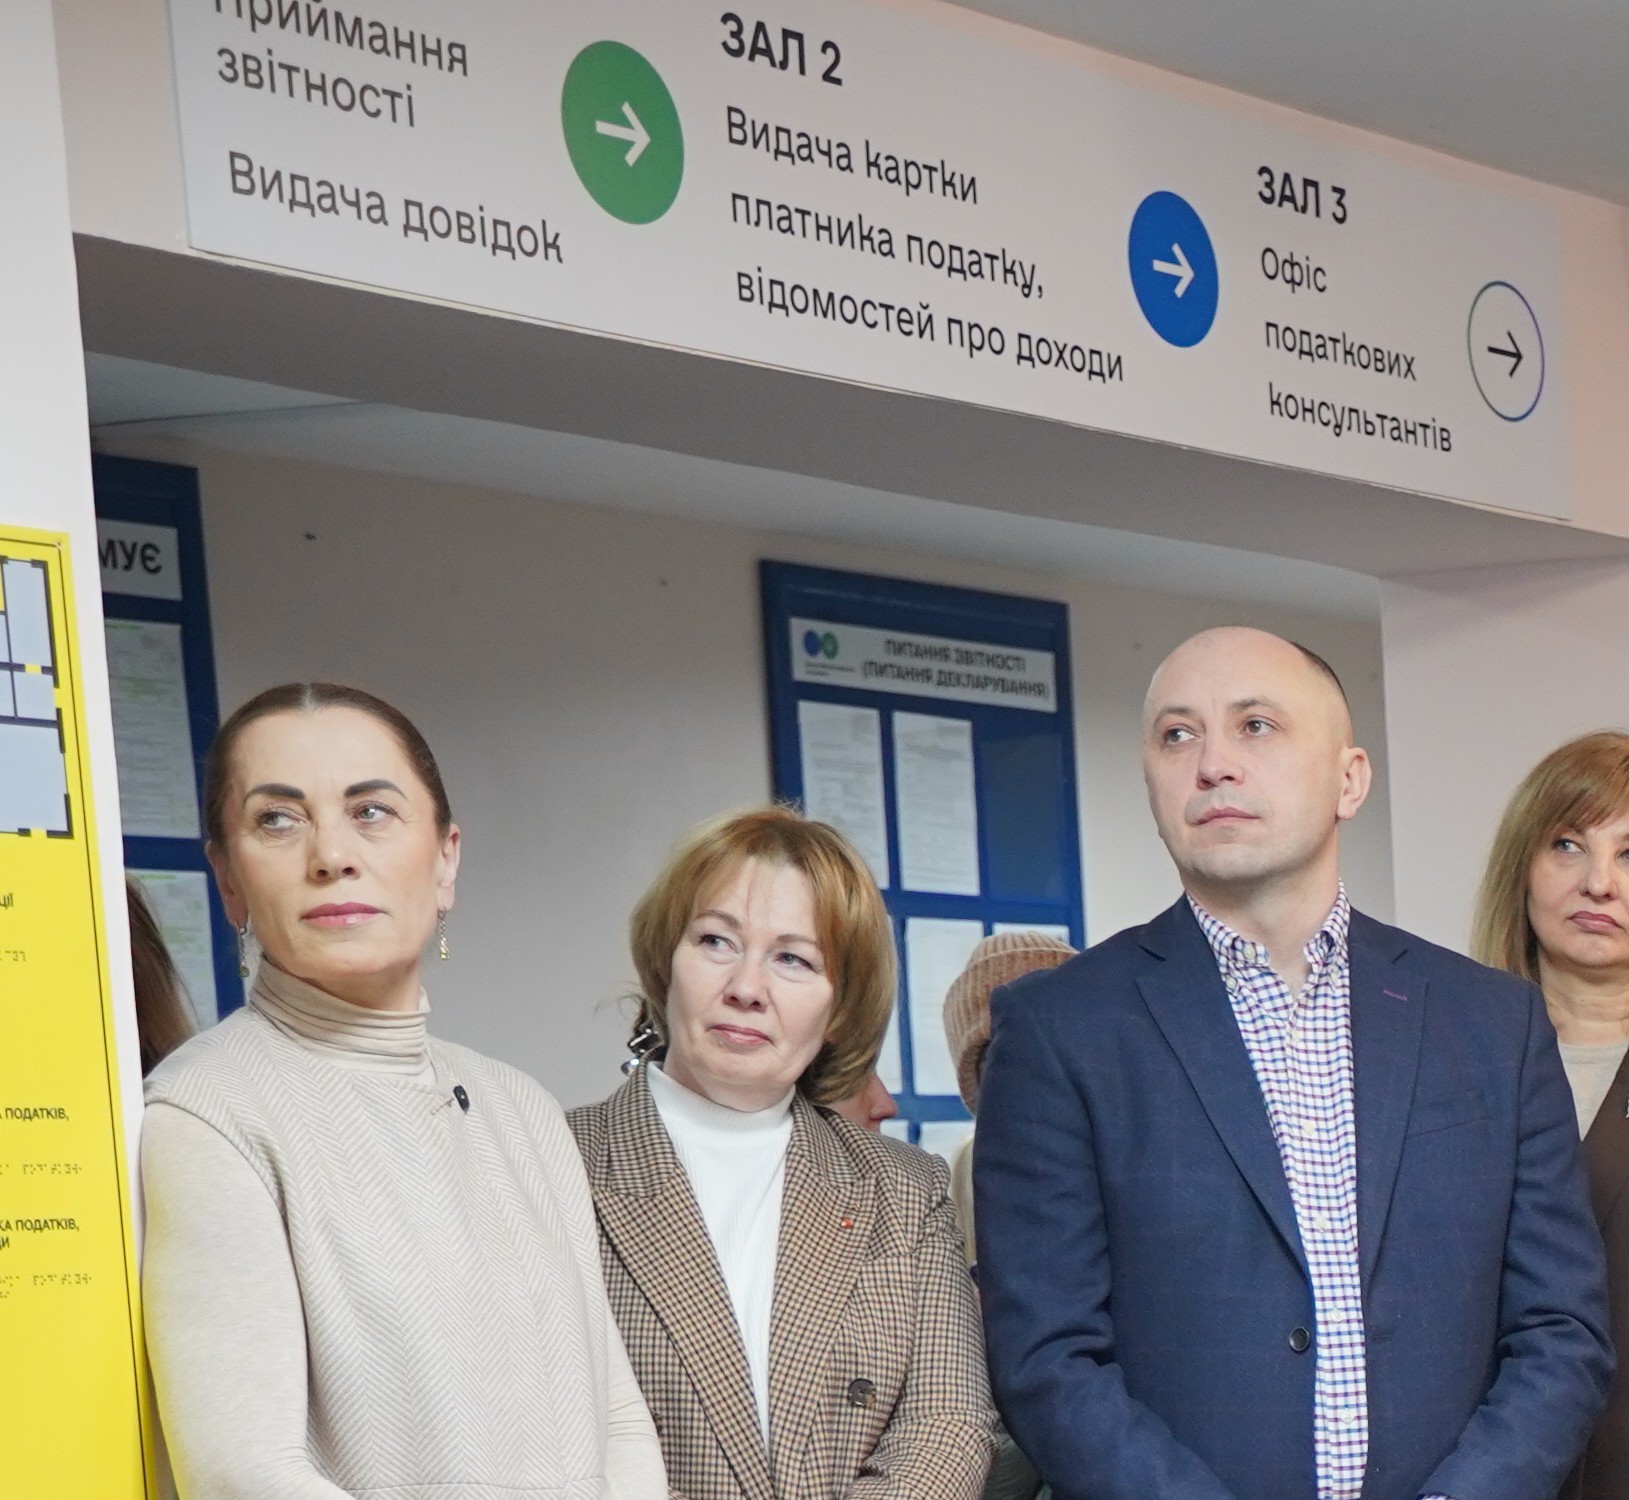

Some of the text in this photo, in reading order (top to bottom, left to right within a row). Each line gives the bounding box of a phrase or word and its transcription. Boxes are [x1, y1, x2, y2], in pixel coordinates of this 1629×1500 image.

[721, 13, 842, 85] ЗАЛ 2
[217, 48, 415, 127] звітності
[727, 106, 976, 204] Видача картки
[229, 151, 562, 263] Видача довідок
[1258, 166, 1346, 224] ЗАЛ 3
[732, 193, 1042, 298] платника податку,
[1262, 247, 1326, 293] Офіс
[737, 267, 1122, 383] відомостей про доходи
[1266, 322, 1415, 380] податкових
[1269, 383, 1451, 452] консультантів
[6, 1107, 69, 1122] ПОДАТКІВ,
[15, 1218, 79, 1233] ПОДАТКІВ,
